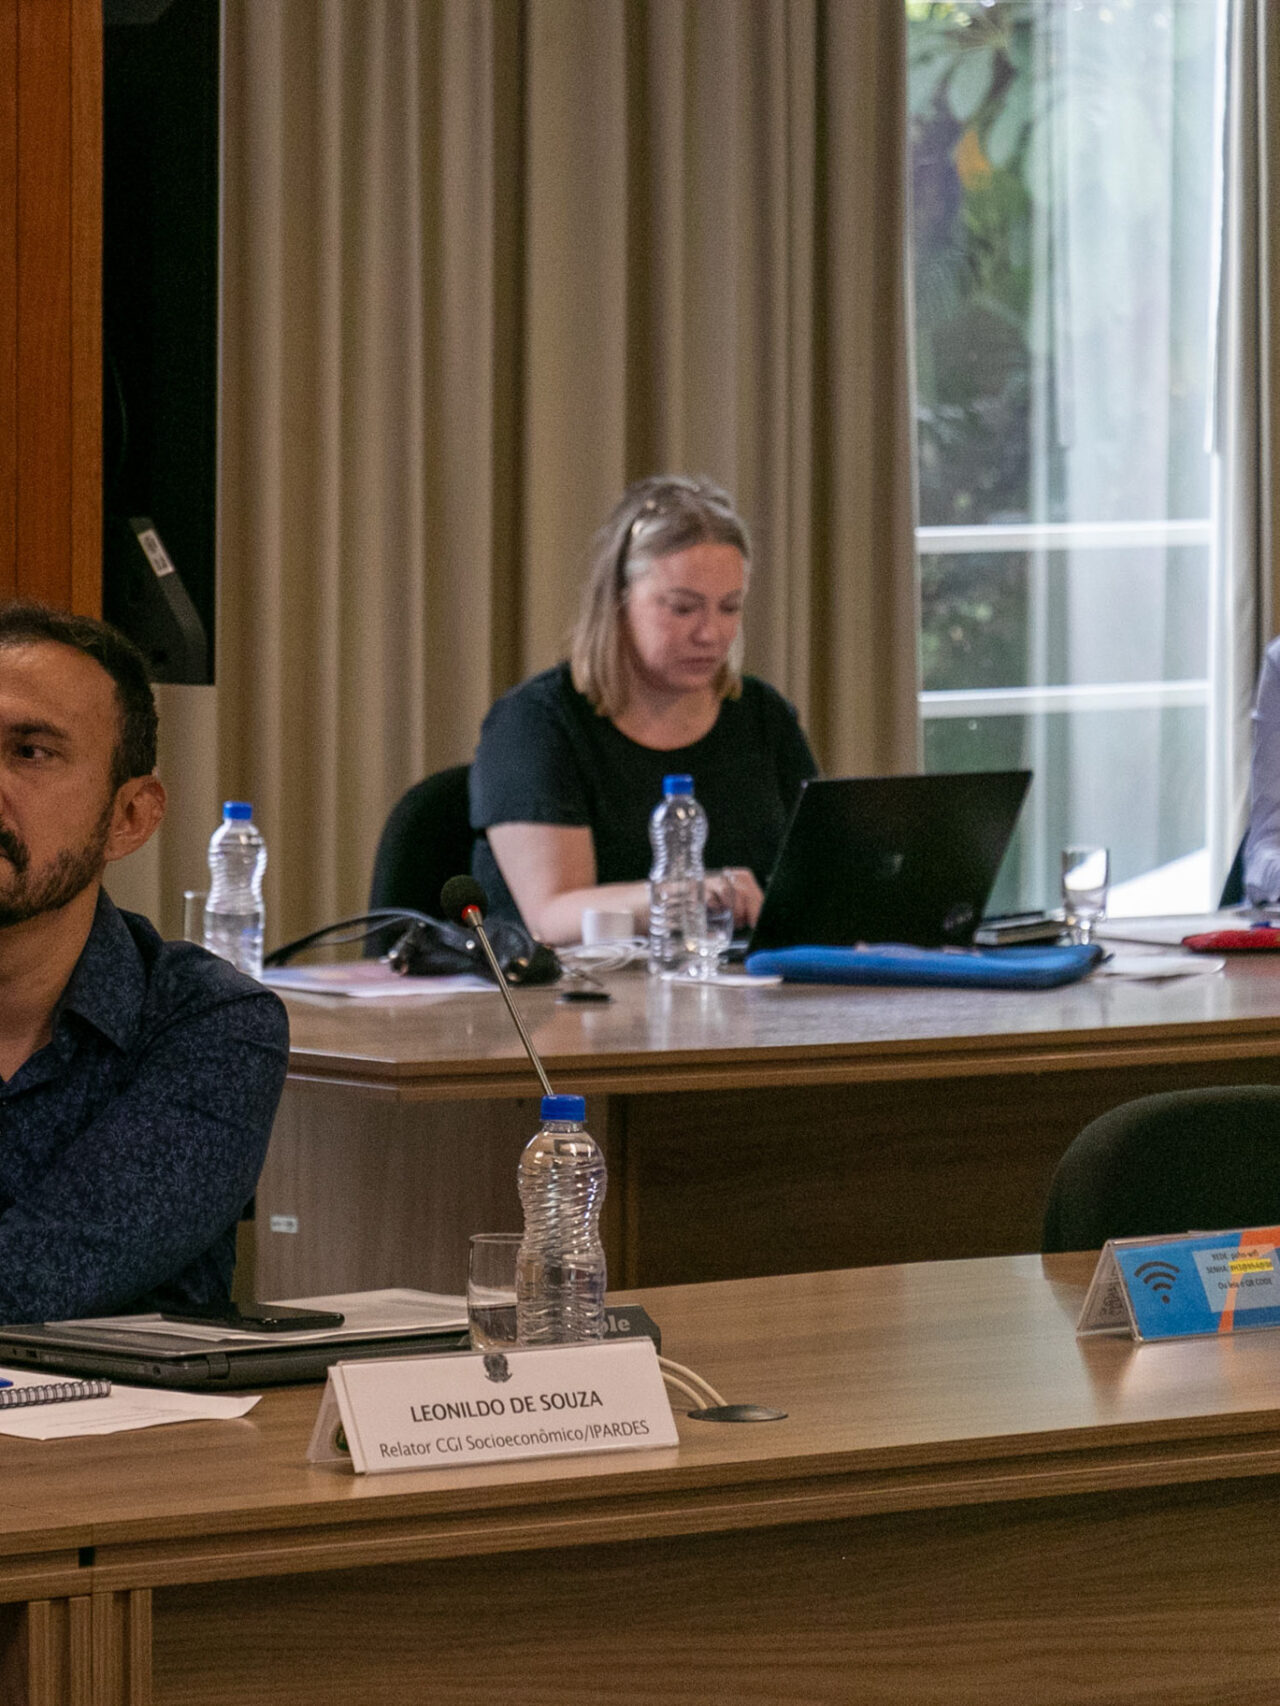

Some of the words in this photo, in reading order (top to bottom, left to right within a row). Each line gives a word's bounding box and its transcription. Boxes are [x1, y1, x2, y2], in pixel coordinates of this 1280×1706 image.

[600, 1314, 631, 1333] ole
[410, 1398, 505, 1423] LEONILDO
[509, 1395, 537, 1414] DE
[539, 1390, 604, 1411] SOUZA
[379, 1441, 431, 1458] Relator
[435, 1436, 463, 1453] CGI
[465, 1419, 650, 1451] Socioeconômico/IPARDES
